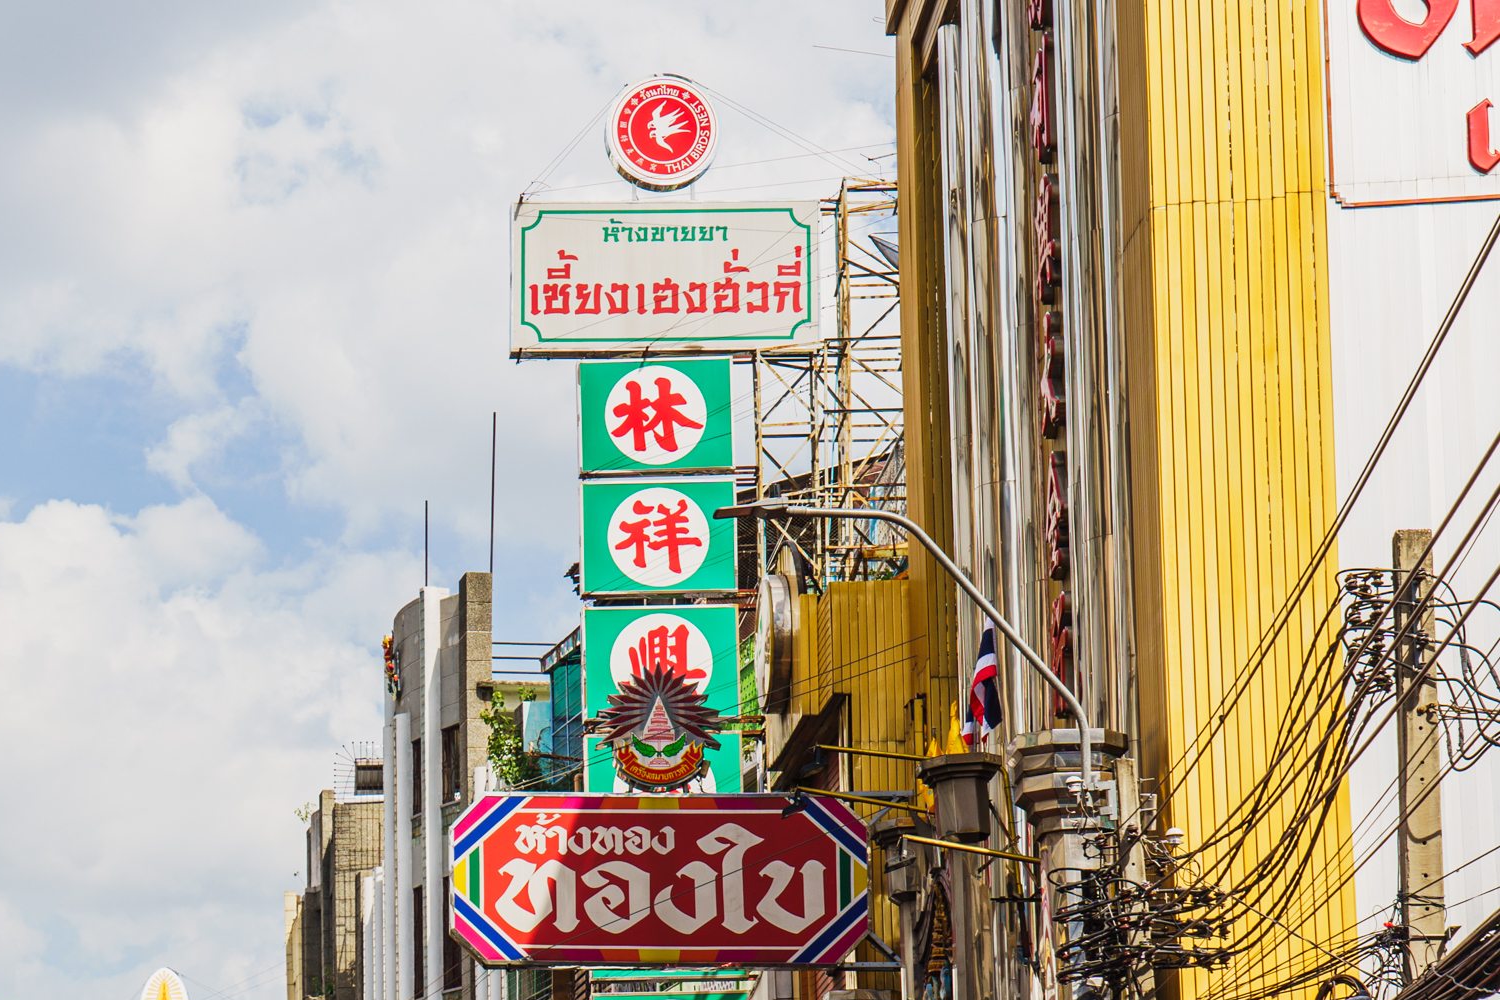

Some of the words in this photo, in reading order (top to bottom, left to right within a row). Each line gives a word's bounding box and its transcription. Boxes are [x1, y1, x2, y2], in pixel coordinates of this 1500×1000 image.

[639, 84, 680, 100] รังนกไทย
[690, 100, 710, 127] NEST
[690, 130, 710, 160] BIRDS
[665, 157, 692, 173] THAI
[602, 218, 728, 242] ห้างขายยา
[514, 813, 676, 856] ห้างทอง
[494, 822, 827, 935] ทองใบ
